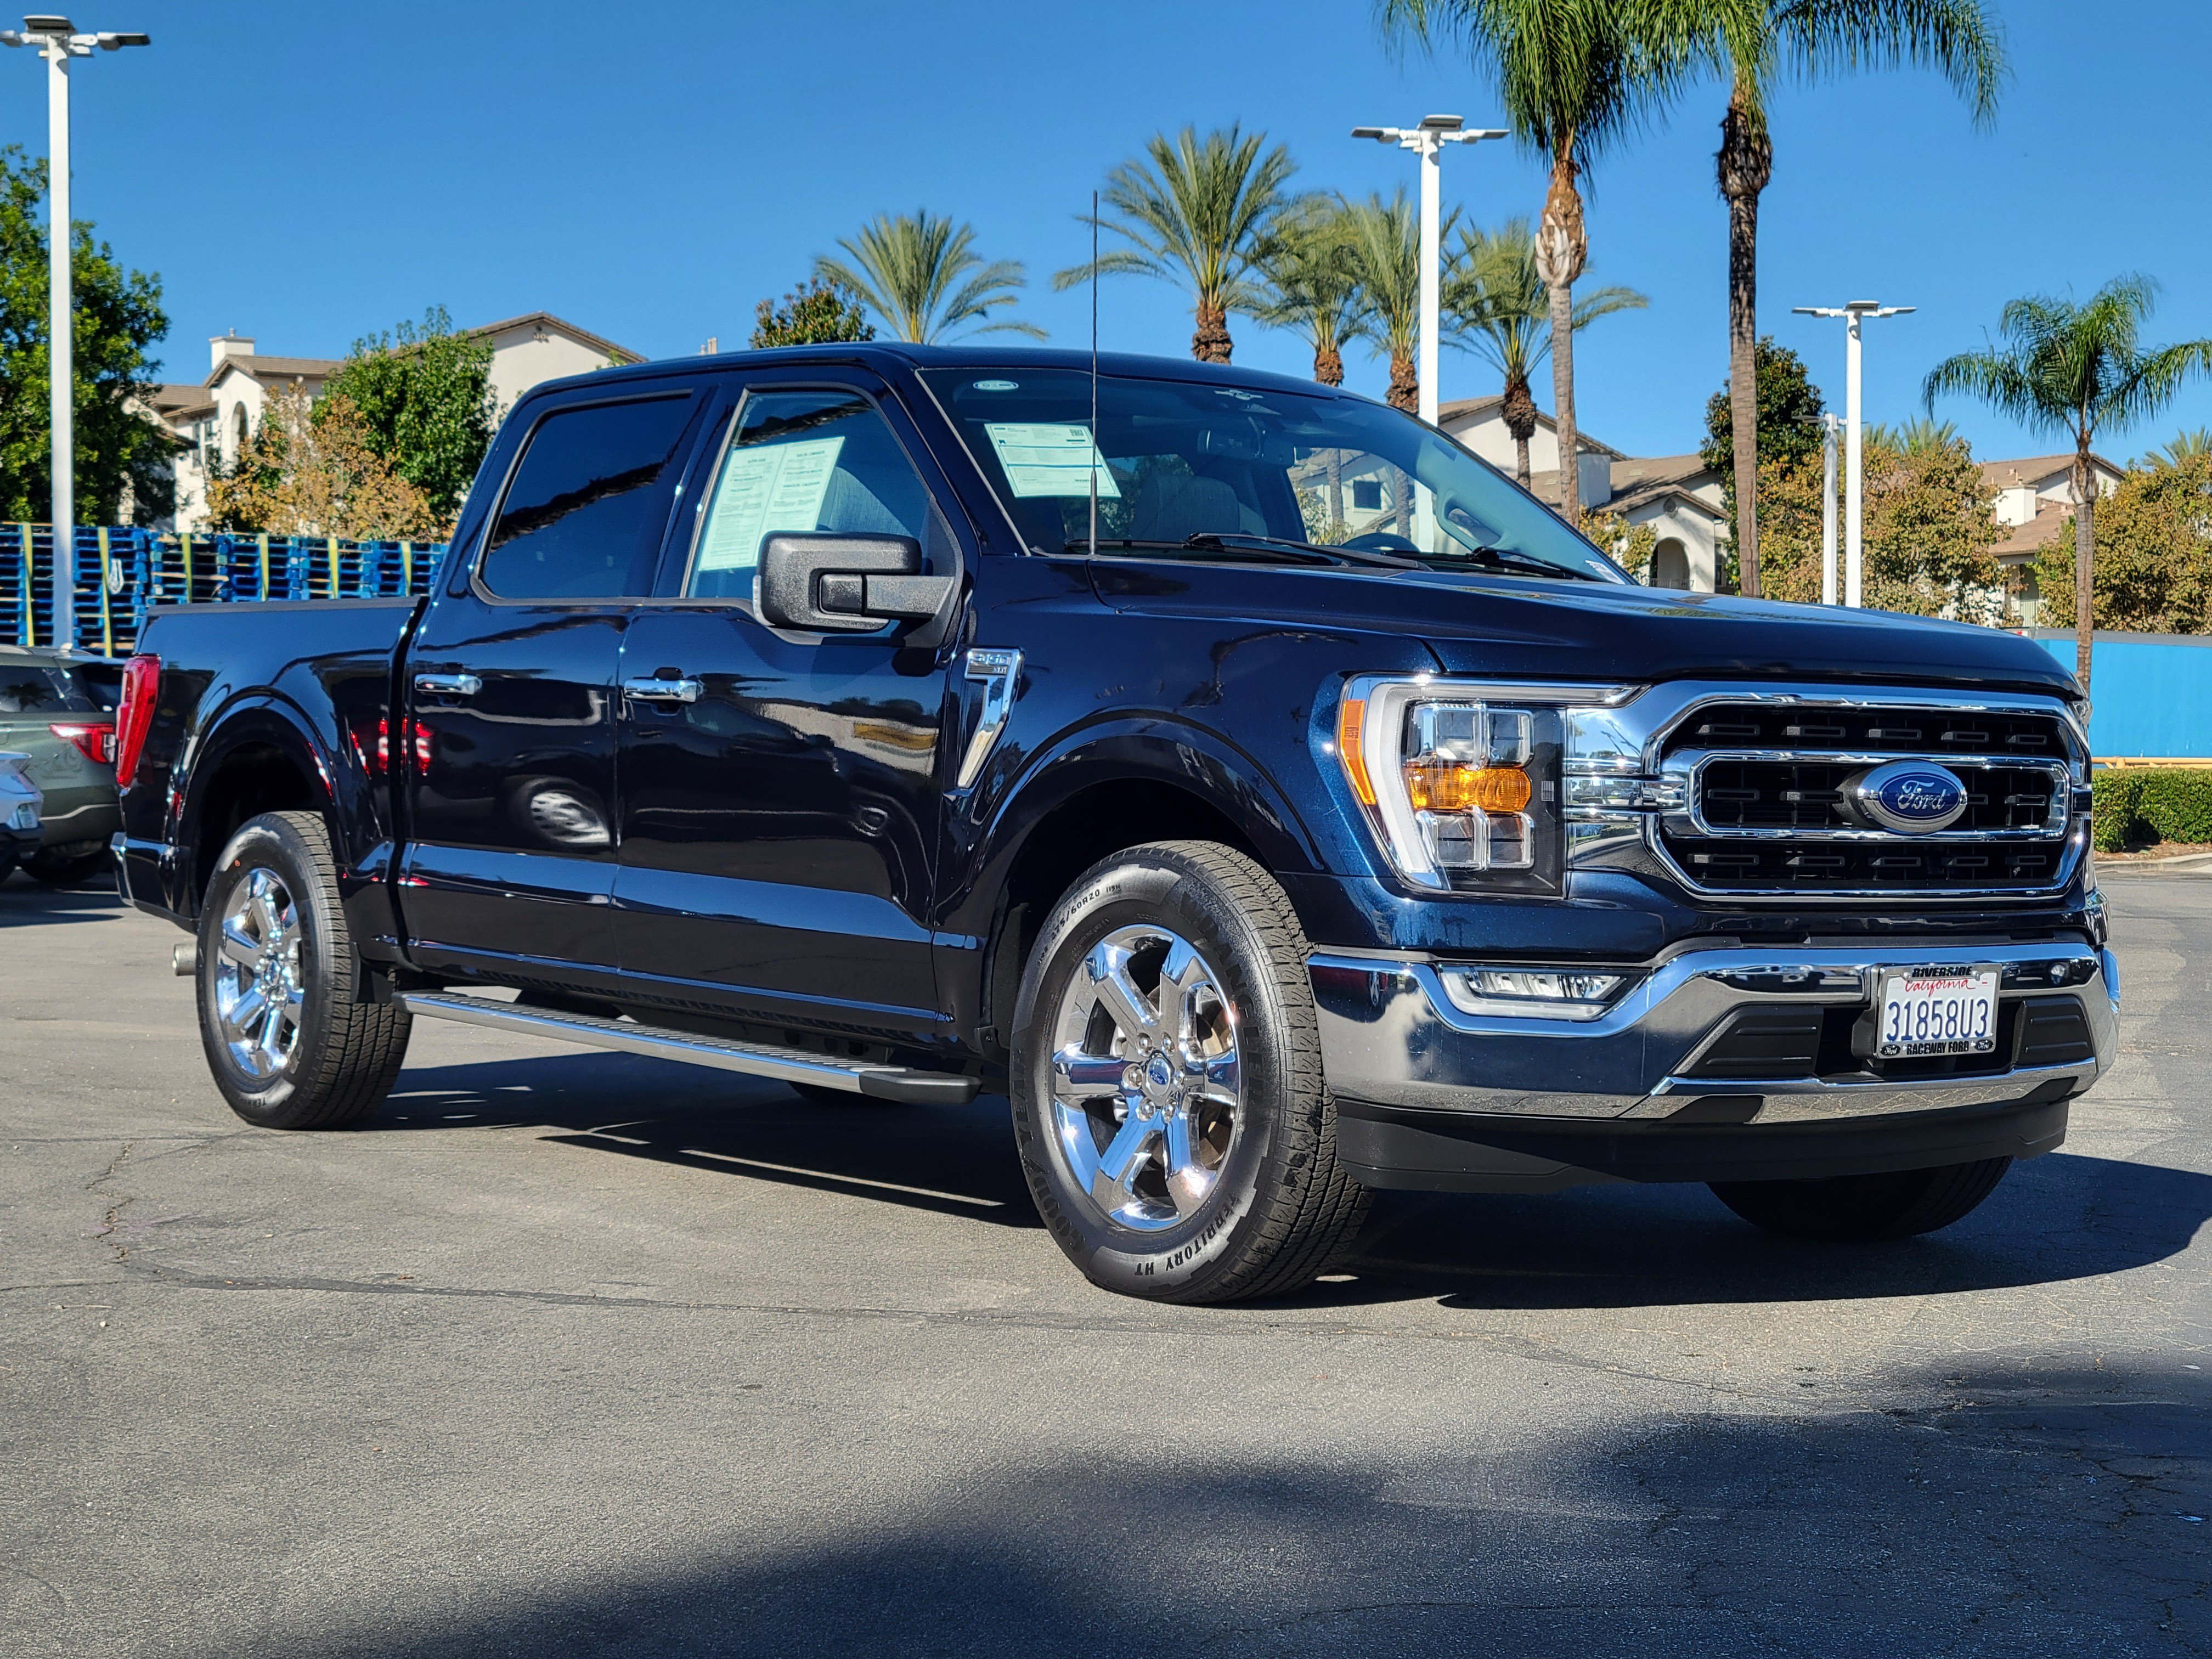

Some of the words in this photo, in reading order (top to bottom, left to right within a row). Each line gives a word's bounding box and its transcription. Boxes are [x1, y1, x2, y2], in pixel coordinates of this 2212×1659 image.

[1898, 780, 1946, 809] Ford
[1051, 889, 1101, 940] 275/60R20
[1912, 966, 1972, 978] RIVERSIDE
[1905, 979, 1976, 997] California
[1887, 999, 1988, 1041] 31858U3
[1906, 1042, 1946, 1055] RACEWAY
[1948, 1041, 1969, 1052] FORD
[1165, 1192, 1242, 1271] TERRITORY
[1135, 1262, 1154, 1276] HT
